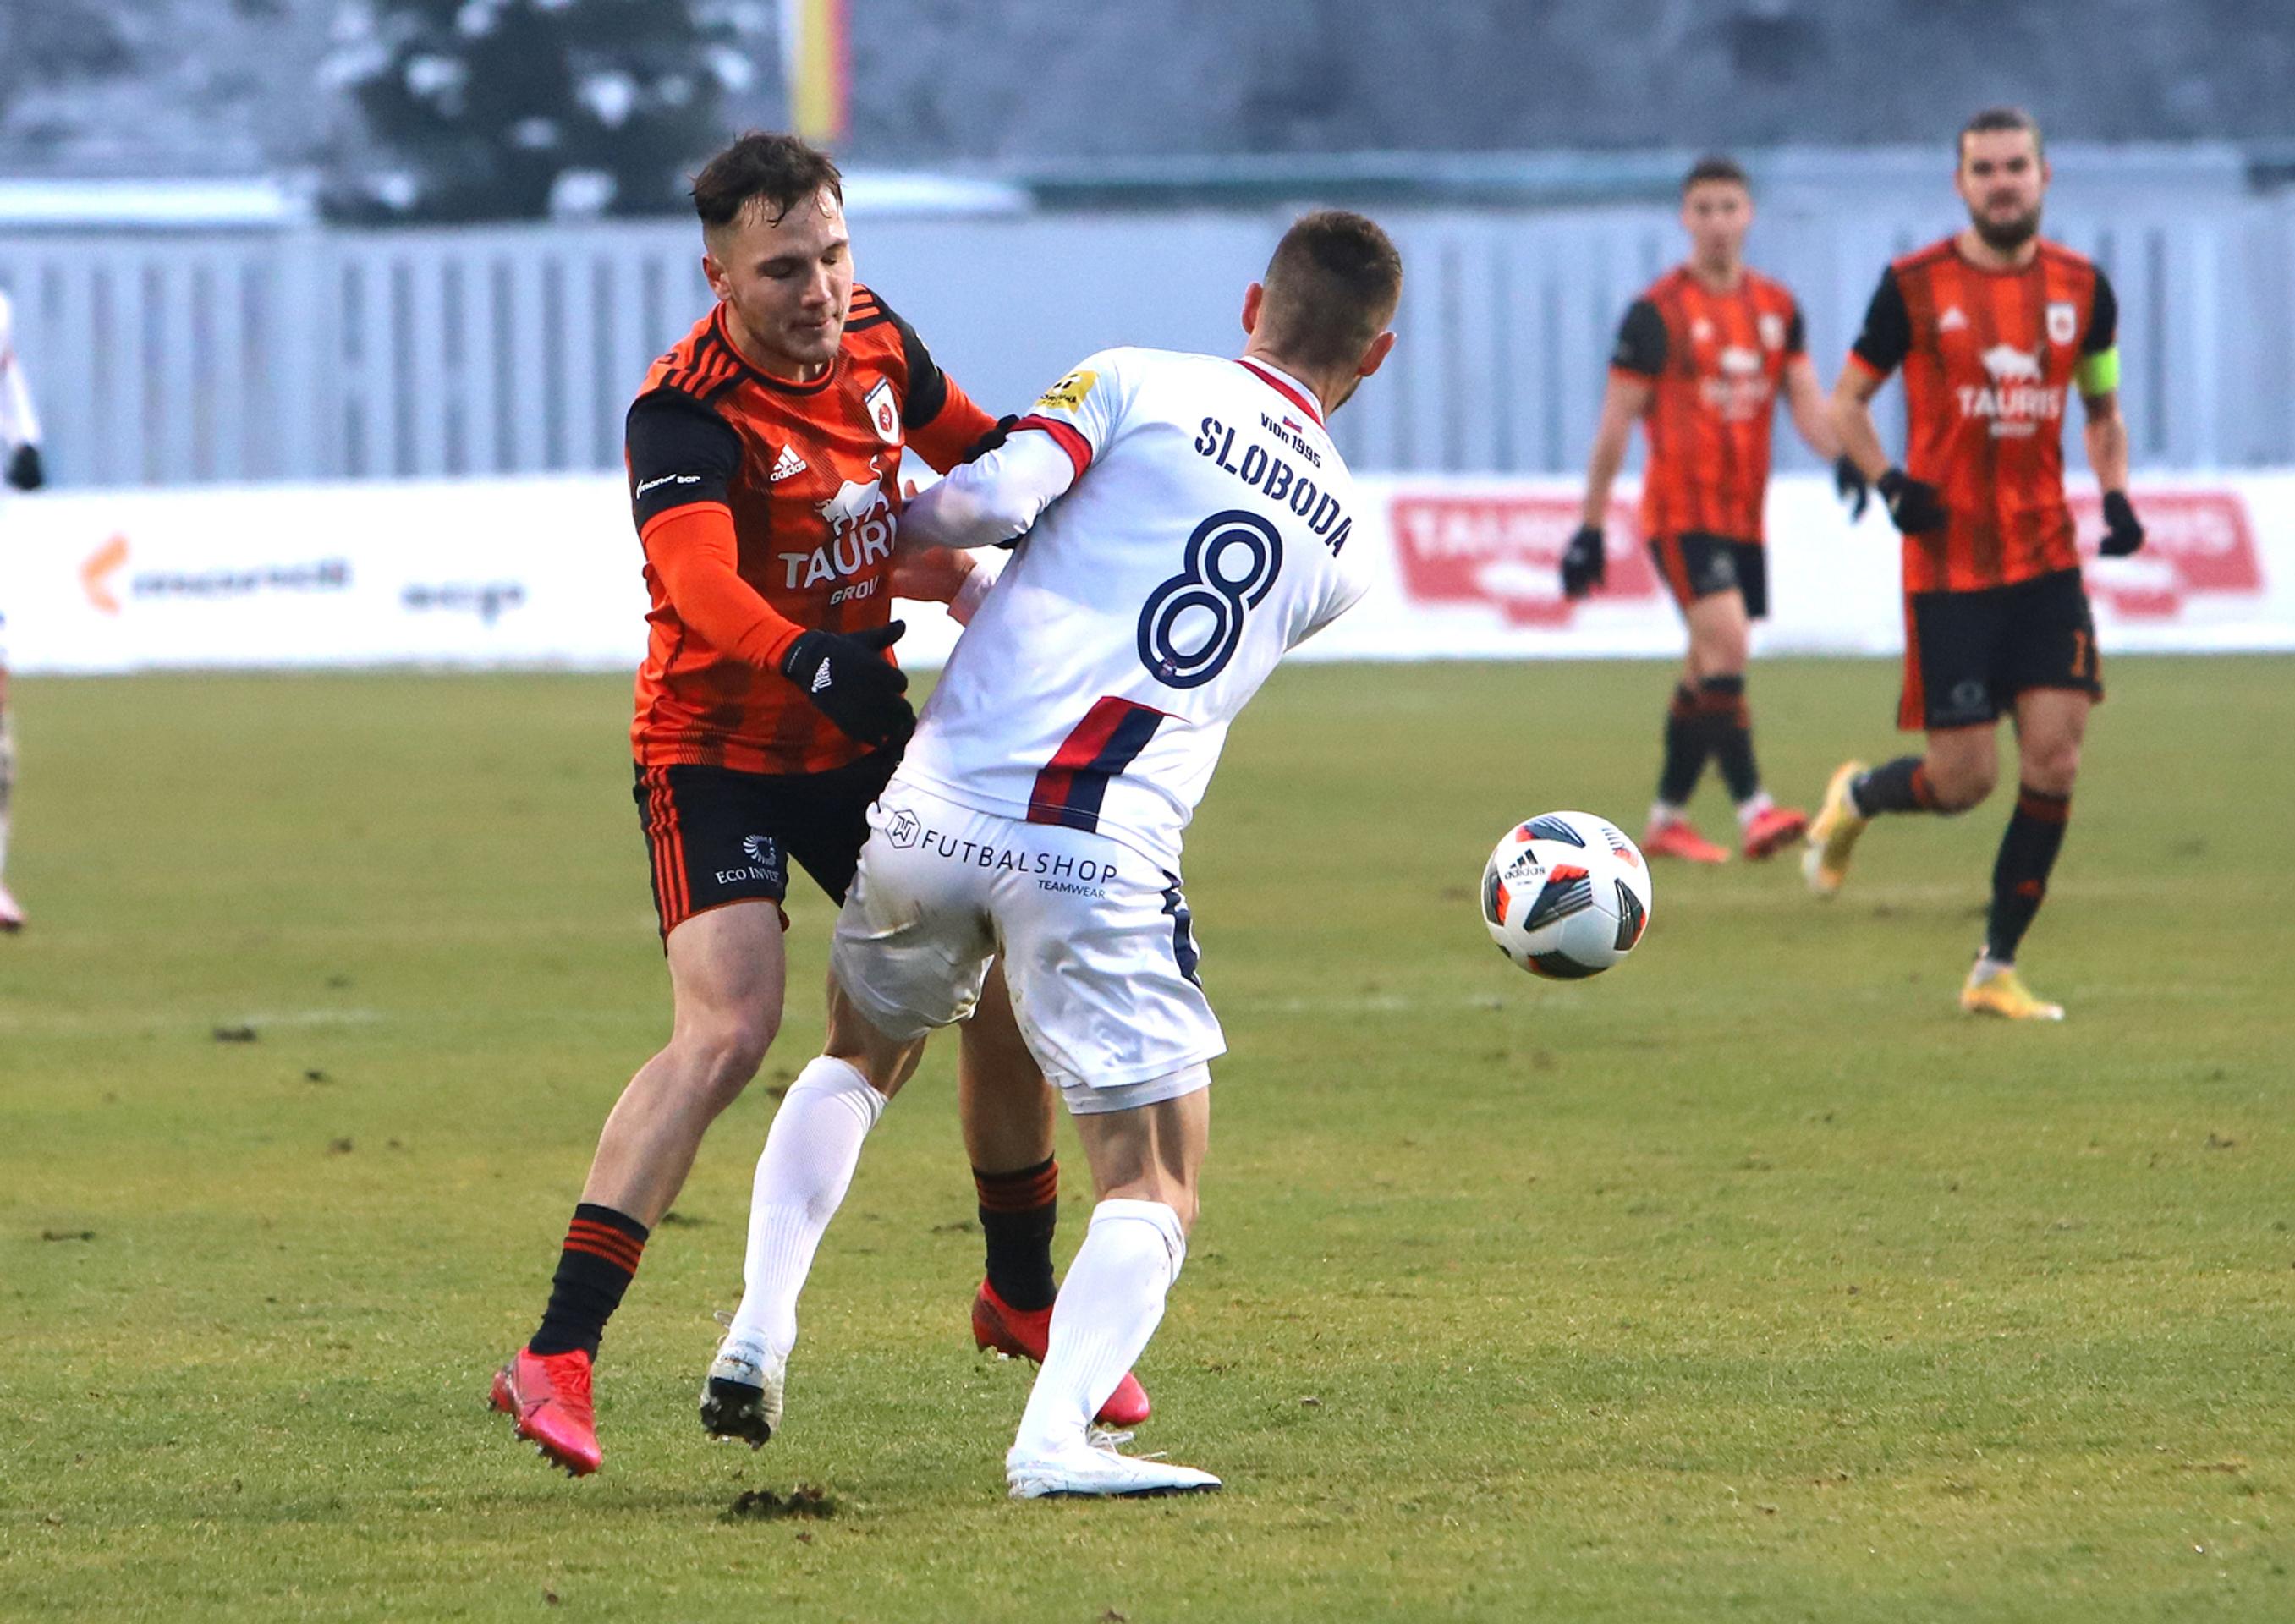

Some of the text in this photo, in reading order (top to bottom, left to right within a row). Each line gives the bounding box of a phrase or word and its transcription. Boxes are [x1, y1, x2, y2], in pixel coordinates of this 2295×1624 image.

[1292, 435, 1321, 468] 1995
[771, 459, 808, 481] adidas
[1195, 417, 1352, 558] SLOBODA
[778, 513, 898, 589] TAURI
[830, 575, 879, 605] GROU
[1137, 509, 1283, 689] 8
[921, 830, 1117, 884] FUTBALSHOP
[1504, 865, 1546, 880] adidas
[1038, 879, 1106, 899] TEAMWEAR
